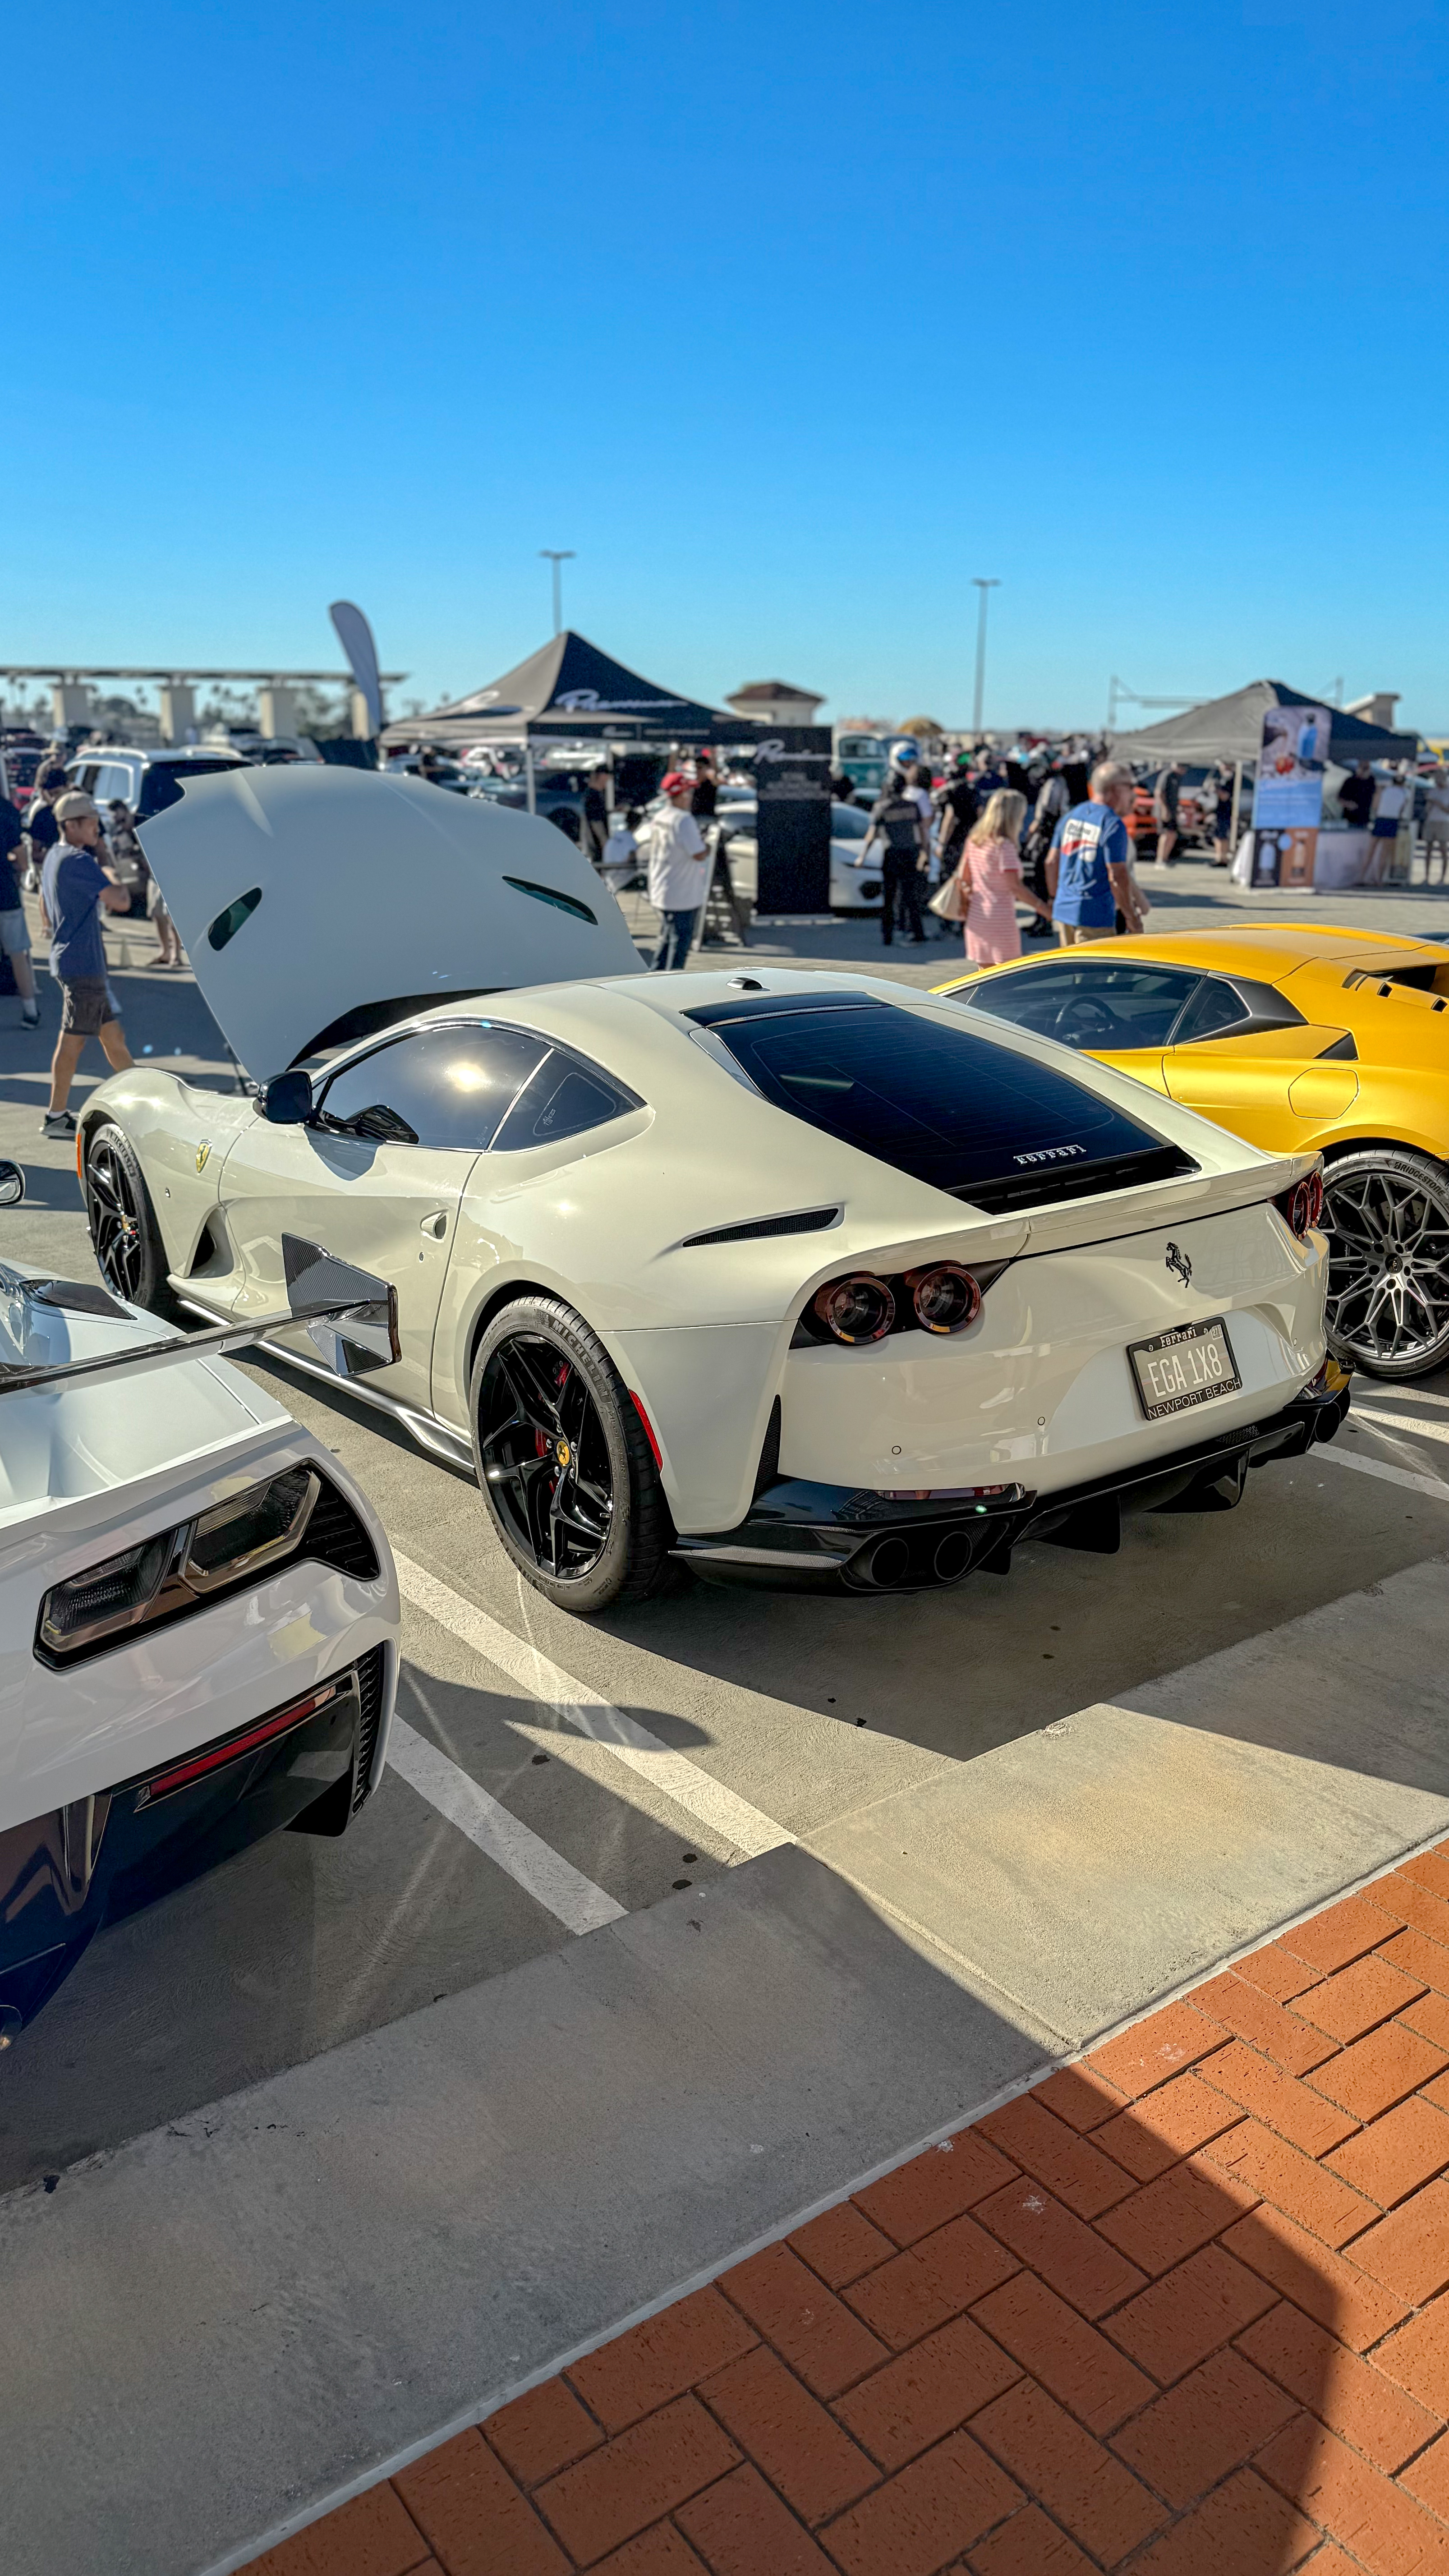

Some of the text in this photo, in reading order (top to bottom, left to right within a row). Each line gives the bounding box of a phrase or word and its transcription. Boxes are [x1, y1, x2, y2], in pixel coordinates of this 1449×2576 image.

[1013, 1145, 1086, 1164] Ferrari
[1393, 1161, 1445, 1196] BRIDGESTONE
[1159, 1327, 1197, 1347] Ferrari
[552, 1320, 609, 1397] MICHELIN
[1147, 1343, 1222, 1397] EGA 1X8
[1148, 1378, 1241, 1420] NEWPORT BEACH
